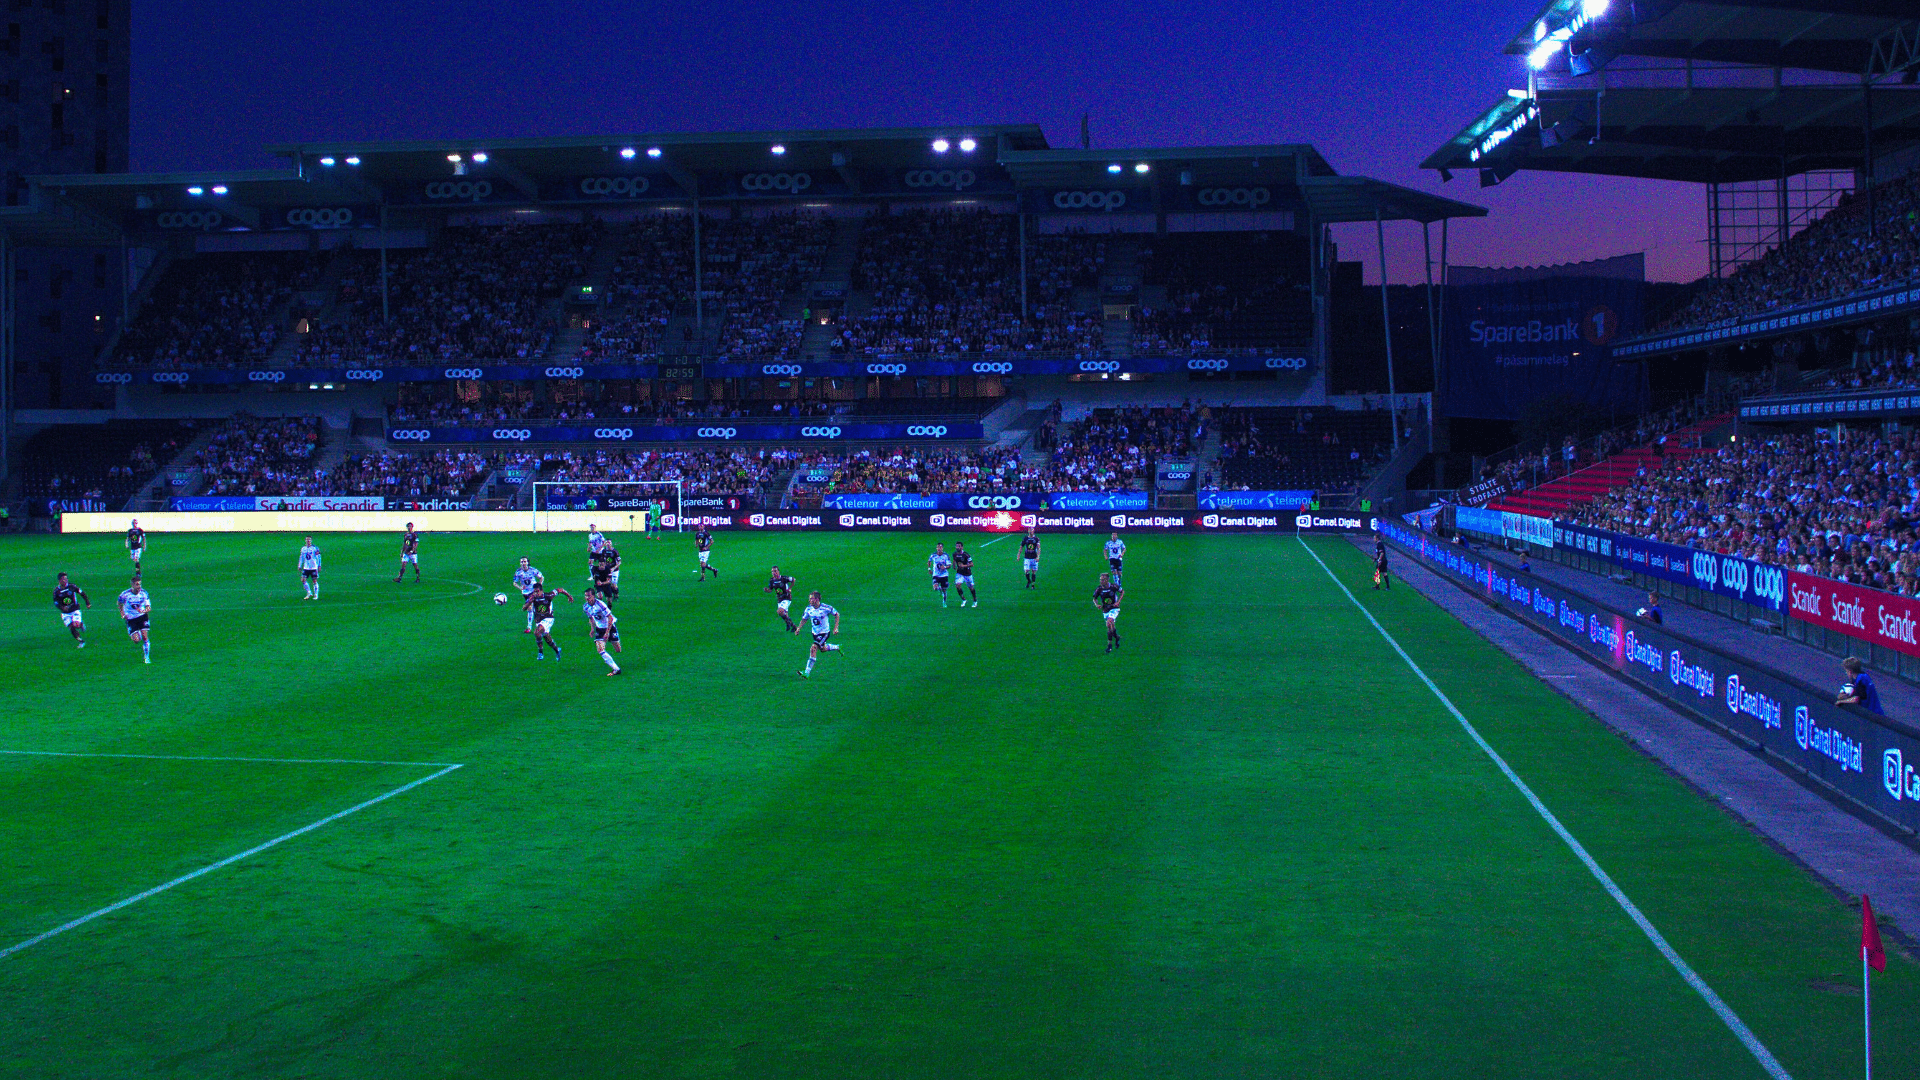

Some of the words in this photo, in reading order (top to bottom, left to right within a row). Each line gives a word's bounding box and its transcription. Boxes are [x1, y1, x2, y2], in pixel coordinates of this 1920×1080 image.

[580, 176, 649, 197] coop
[741, 172, 811, 193] coop
[904, 169, 975, 190] coop
[425, 180, 492, 201] coop
[1198, 187, 1270, 208] coop
[1053, 190, 1126, 212] coop
[287, 207, 352, 229] coop
[1470, 318, 1579, 347] SpareBank
[1592, 312, 1604, 338] 1
[96, 373, 132, 384] coop
[152, 372, 189, 384] coop
[248, 371, 286, 382] coop
[346, 370, 384, 382] coop
[444, 368, 483, 380] coop
[544, 366, 584, 379] coop
[762, 364, 802, 378] coop
[867, 363, 906, 376] coop
[972, 362, 1013, 375] coop
[1079, 360, 1120, 374] coop
[1187, 359, 1228, 372] coop
[1265, 357, 1306, 370] coop
[666, 368, 694, 378] 82:59
[392, 429, 431, 442] coop
[492, 428, 531, 441] coop
[594, 428, 634, 440] coop
[697, 427, 737, 440] coop
[802, 426, 842, 439] coop
[907, 425, 948, 438] coop
[1468, 485, 1506, 505] TROFASTE
[1470, 478, 1497, 495] STOLTE
[260, 500, 314, 510] Scndic
[324, 500, 379, 510] Scandic
[844, 500, 879, 509] telenor
[900, 500, 935, 508] telenor
[968, 496, 1021, 510] coop
[1066, 498, 1098, 506] telenor
[1115, 498, 1146, 506] telenor
[1217, 496, 1254, 506] telenor
[702, 516, 732, 527] Digital
[766, 516, 791, 526] Canal
[792, 516, 822, 527] Digital
[856, 516, 881, 526] Canal
[882, 516, 911, 527] Digital
[947, 516, 972, 526] Canal
[973, 516, 998, 527] Digita
[1038, 516, 1063, 526] Canal
[1064, 516, 1094, 527] Digital
[1128, 516, 1153, 526] Canal
[1154, 516, 1184, 527] Digital
[1220, 516, 1248, 526] Canal
[1249, 516, 1277, 527] Digital
[1313, 516, 1337, 526] Canal
[1338, 516, 1362, 528] Digital
[1693, 552, 1718, 590] coop
[1722, 558, 1748, 599] coop
[1754, 564, 1784, 610] coop
[1791, 582, 1822, 616] Scandic
[1832, 592, 1865, 630] Scandic
[1878, 604, 1917, 646] Scandic
[1680, 660, 1695, 688] Canal
[1696, 666, 1714, 698] Digital
[1740, 685, 1758, 718] Canal
[1758, 693, 1781, 729] Digital
[1809, 718, 1832, 758] Canal
[1832, 730, 1863, 774] Digital
